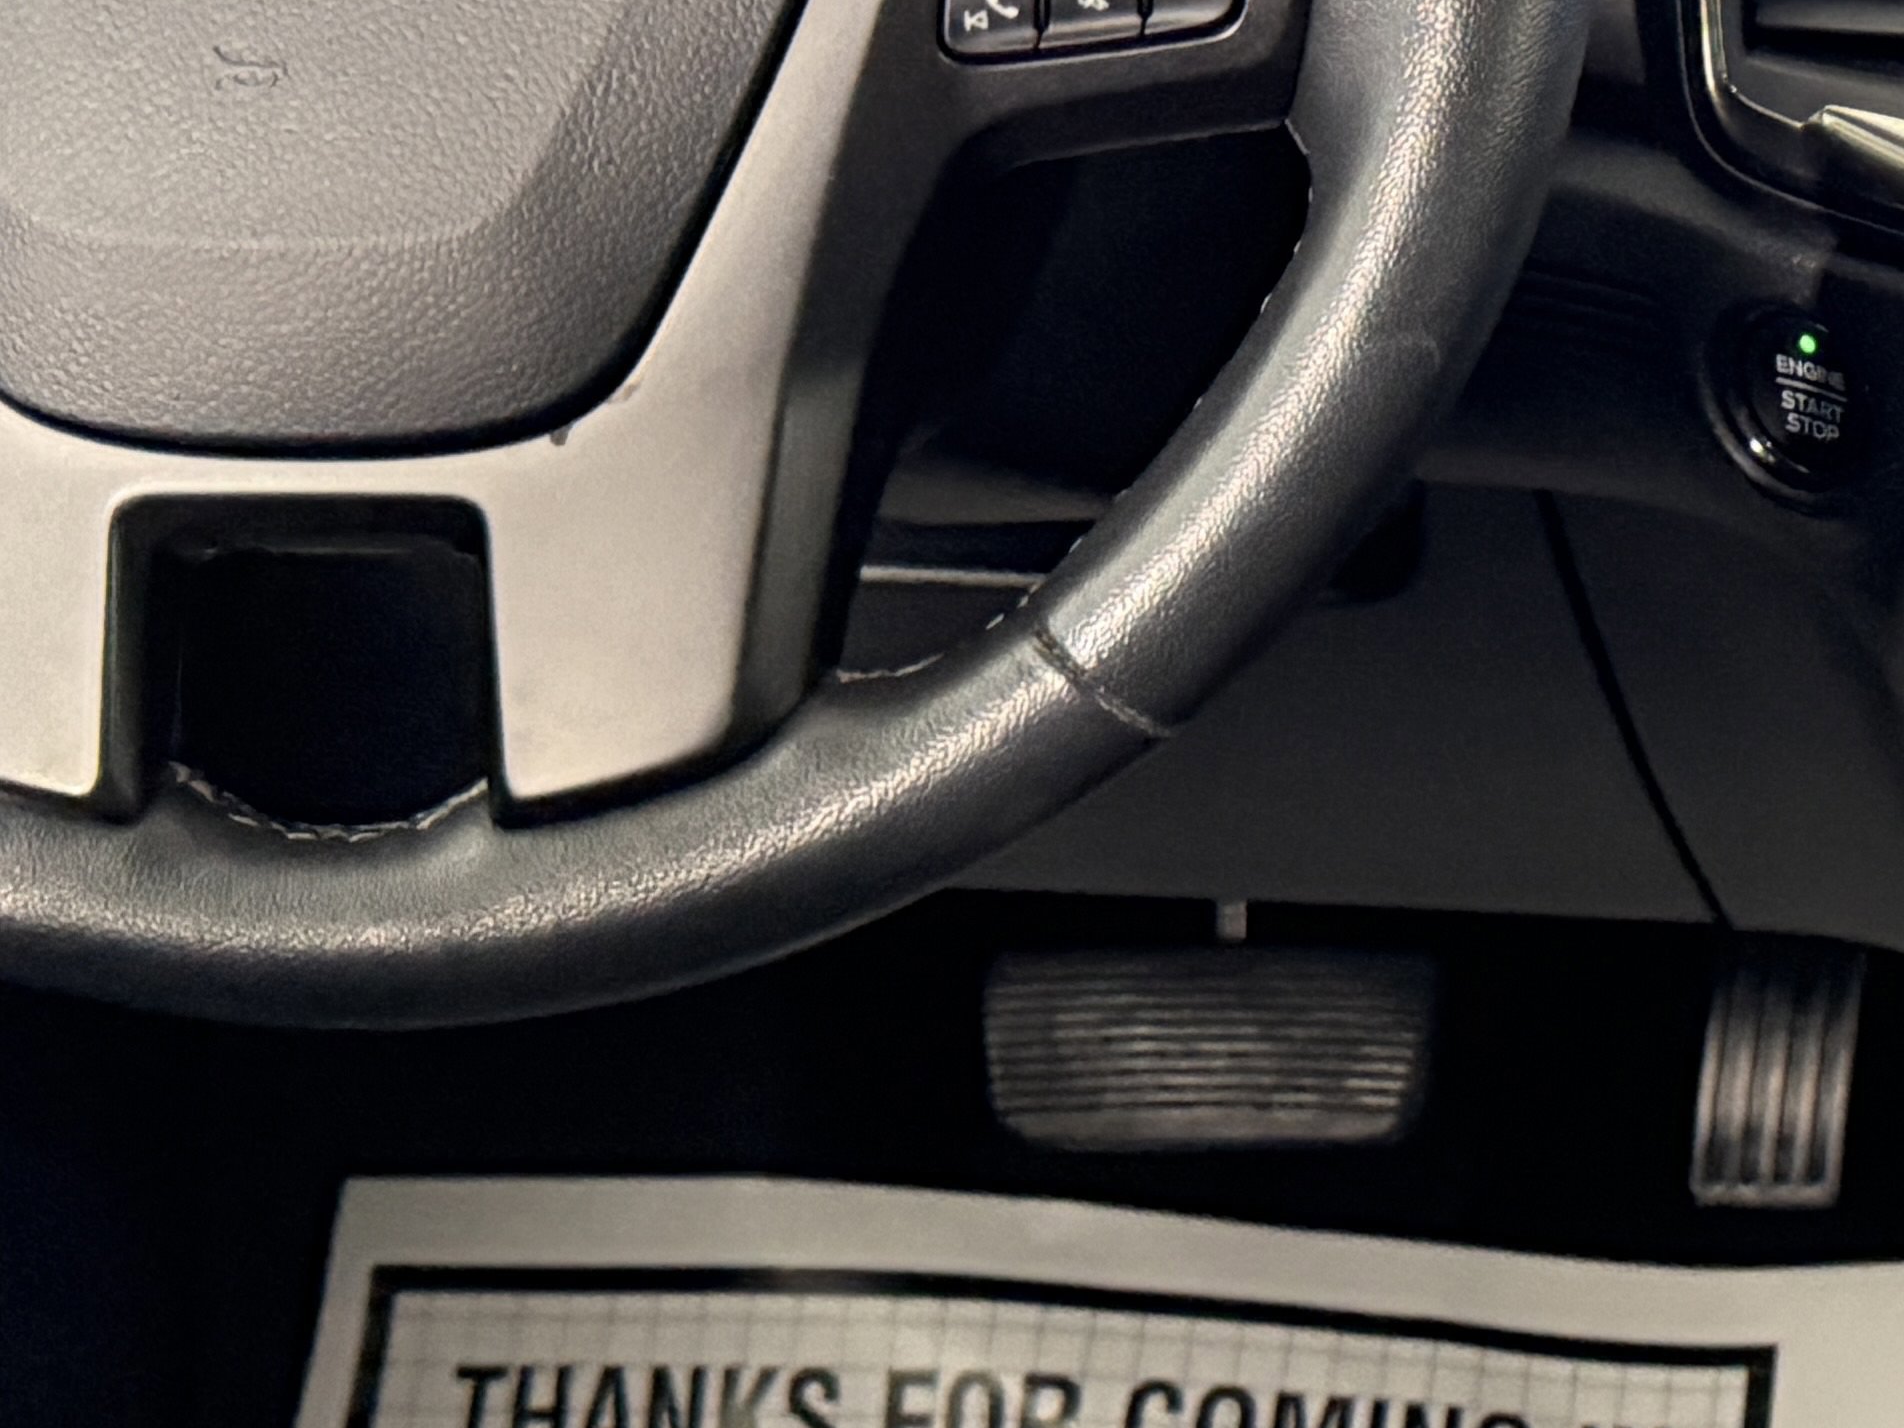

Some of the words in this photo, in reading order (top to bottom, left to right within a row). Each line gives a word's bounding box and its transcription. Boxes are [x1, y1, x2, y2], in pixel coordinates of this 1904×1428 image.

[1775, 353, 1847, 391] ENGINE
[1780, 390, 1844, 424] START
[1785, 412, 1840, 442] STOP
